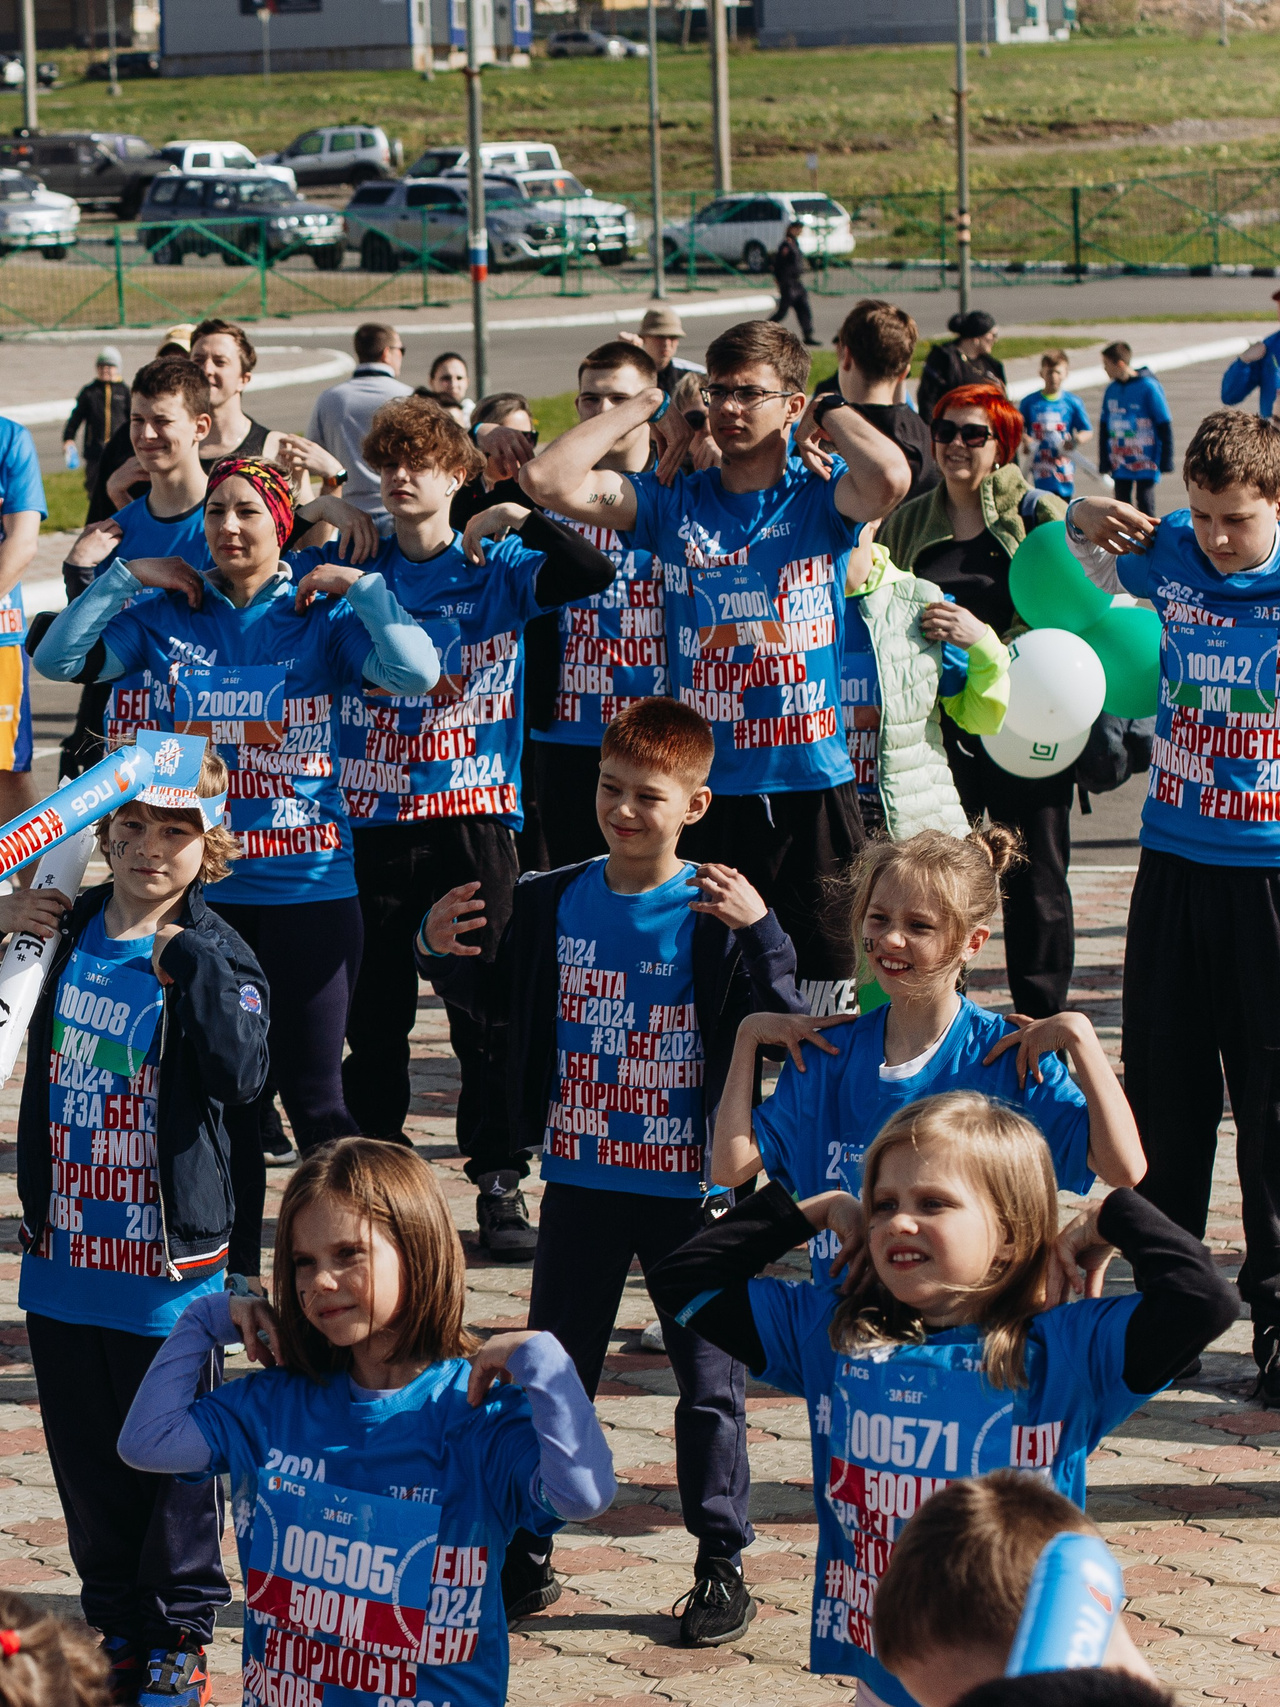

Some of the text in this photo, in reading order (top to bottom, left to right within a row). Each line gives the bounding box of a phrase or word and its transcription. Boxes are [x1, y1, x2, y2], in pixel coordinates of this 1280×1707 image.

[735, 620, 767, 646] 5КМ
[1180, 626, 1195, 636] ПСБ
[461, 630, 518, 676] #ЦЕЛЬ
[563, 635, 668, 667] #ГОРДОСТ
[1186, 651, 1252, 684] 10042
[194, 669, 211, 677] ПСБ
[469, 660, 516, 694] 2024
[559, 663, 615, 695] БОВЬ
[692, 652, 807, 692] #ГОРДОСТЬ
[197, 690, 264, 717] 20020
[781, 679, 826, 716] 2024
[1200, 685, 1232, 713] 1КМ
[211, 720, 246, 744] 5КМ
[283, 723, 332, 754] 2024
[365, 726, 477, 765] #ГОРДОСТЬ
[733, 705, 836, 750] #ЕДИНСТВО
[157, 767, 176, 777] .рф
[237, 743, 333, 778] #МОМЕНТ
[450, 753, 506, 790] 2024
[1255, 760, 1280, 791] 20
[72, 780, 114, 818] ПСБ
[228, 769, 297, 799] ДОСТЬ
[397, 782, 518, 822] #ЕДИНСТВО
[271, 797, 322, 829] 2024
[1199, 785, 1280, 822] #ЕДИН
[557, 935, 597, 968] 2024
[559, 964, 627, 1000] #МЕЧТА
[798, 977, 858, 1018] NIKE
[58, 982, 131, 1036] 10008
[59, 1024, 101, 1065] 1КМ
[617, 1057, 706, 1089] #МОМЕНТ
[62, 1090, 158, 1132] #ЗАБЕГ2
[560, 1078, 670, 1117] #ГОРДОСТЬ
[643, 1116, 695, 1145] 2024
[91, 1130, 159, 1168] #МОМ
[48, 1191, 164, 1242] ОВЬ 20
[70, 1233, 171, 1279] #ЕДИНС
[850, 1365, 870, 1381] ПСБ
[850, 1409, 960, 1472] 00571
[282, 1481, 306, 1498] ПСБ
[282, 1524, 398, 1595] 00505
[430, 1545, 488, 1587] ЕЛЬ
[427, 1586, 482, 1627] 024
[264, 1626, 418, 1699] #ГОРДОСТЬ
